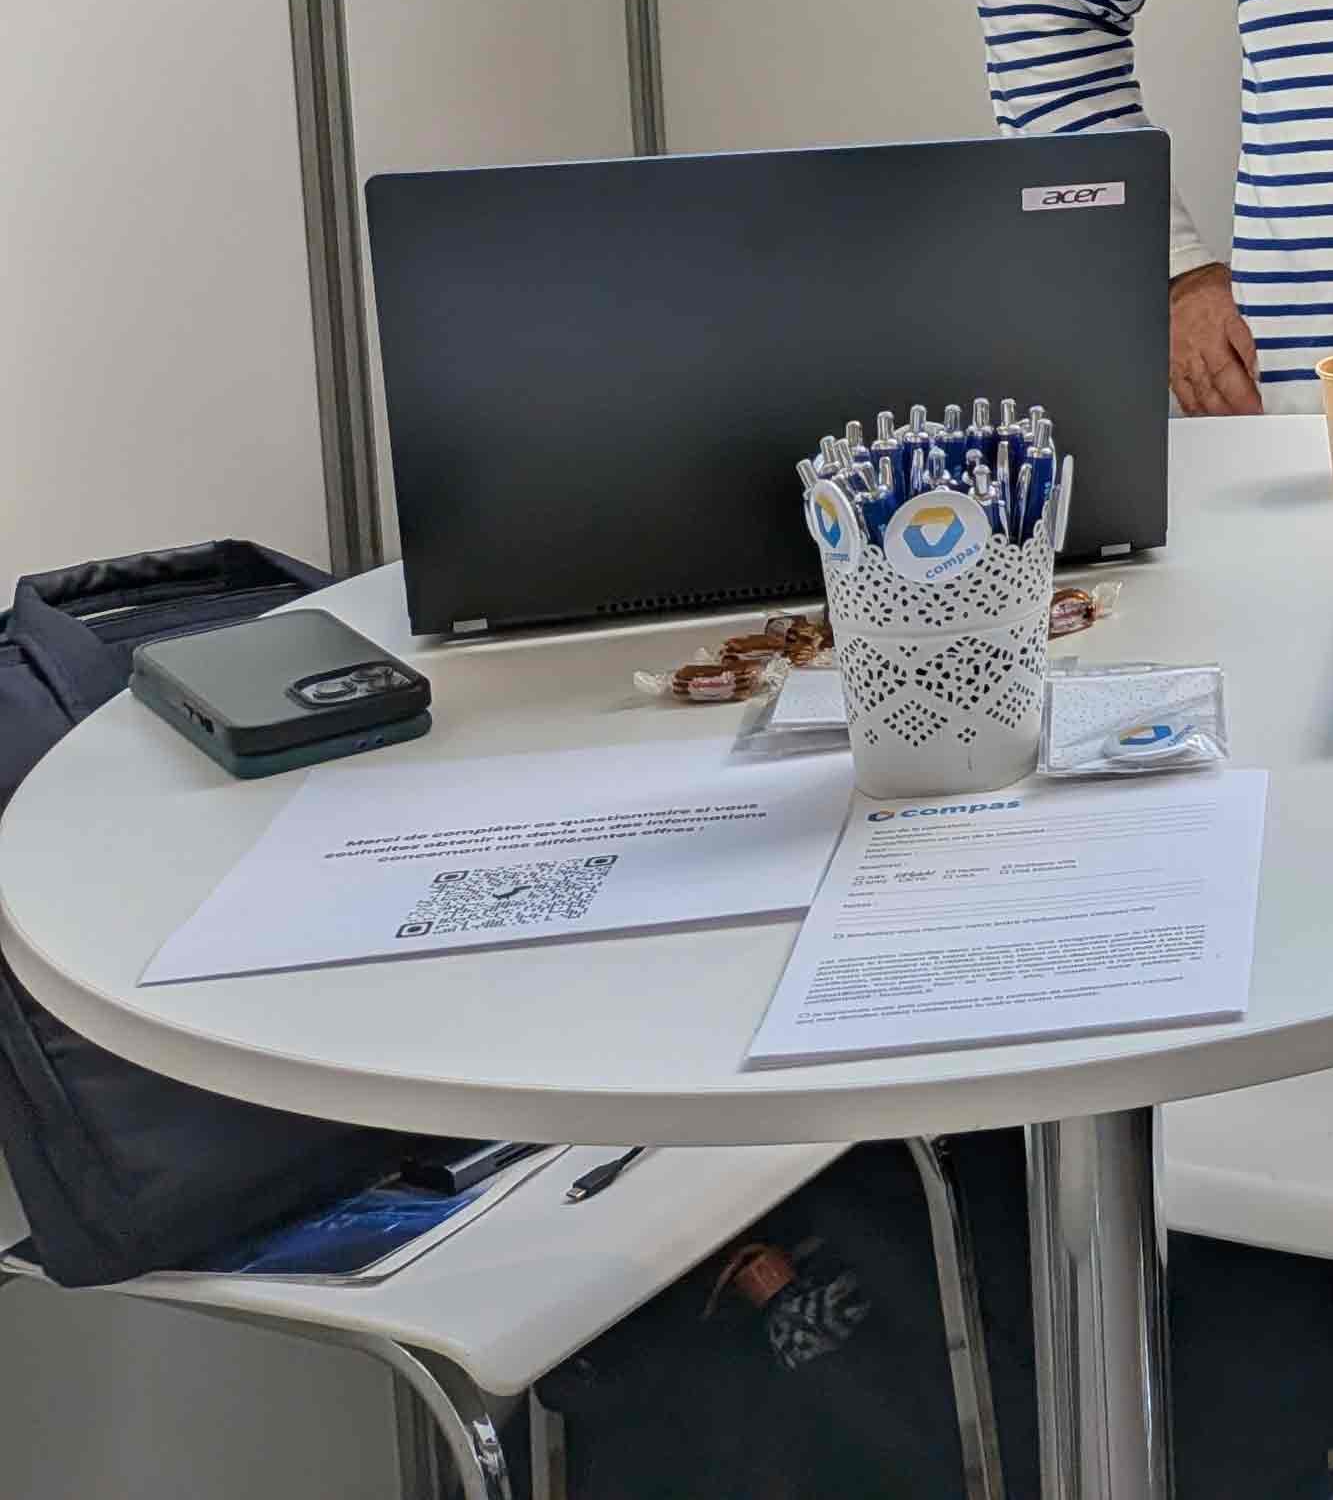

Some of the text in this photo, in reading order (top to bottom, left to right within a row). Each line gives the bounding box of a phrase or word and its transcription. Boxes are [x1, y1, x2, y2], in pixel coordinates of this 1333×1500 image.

[1042, 187, 1107, 205] acer
[926, 541, 982, 581] compas
[345, 803, 759, 847] Merci de compléter ce questionnaire si vous
[899, 800, 1022, 819] compas
[324, 843, 420, 859] souhaitez
[424, 836, 494, 849] obtenir
[526, 827, 577, 839] devis
[581, 825, 605, 834] ou
[610, 821, 642, 831] des
[646, 811, 768, 827] informations
[377, 846, 492, 863] concernant
[495, 843, 530, 851] nos
[534, 831, 638, 847] différentes
[641, 825, 696, 836] offres
